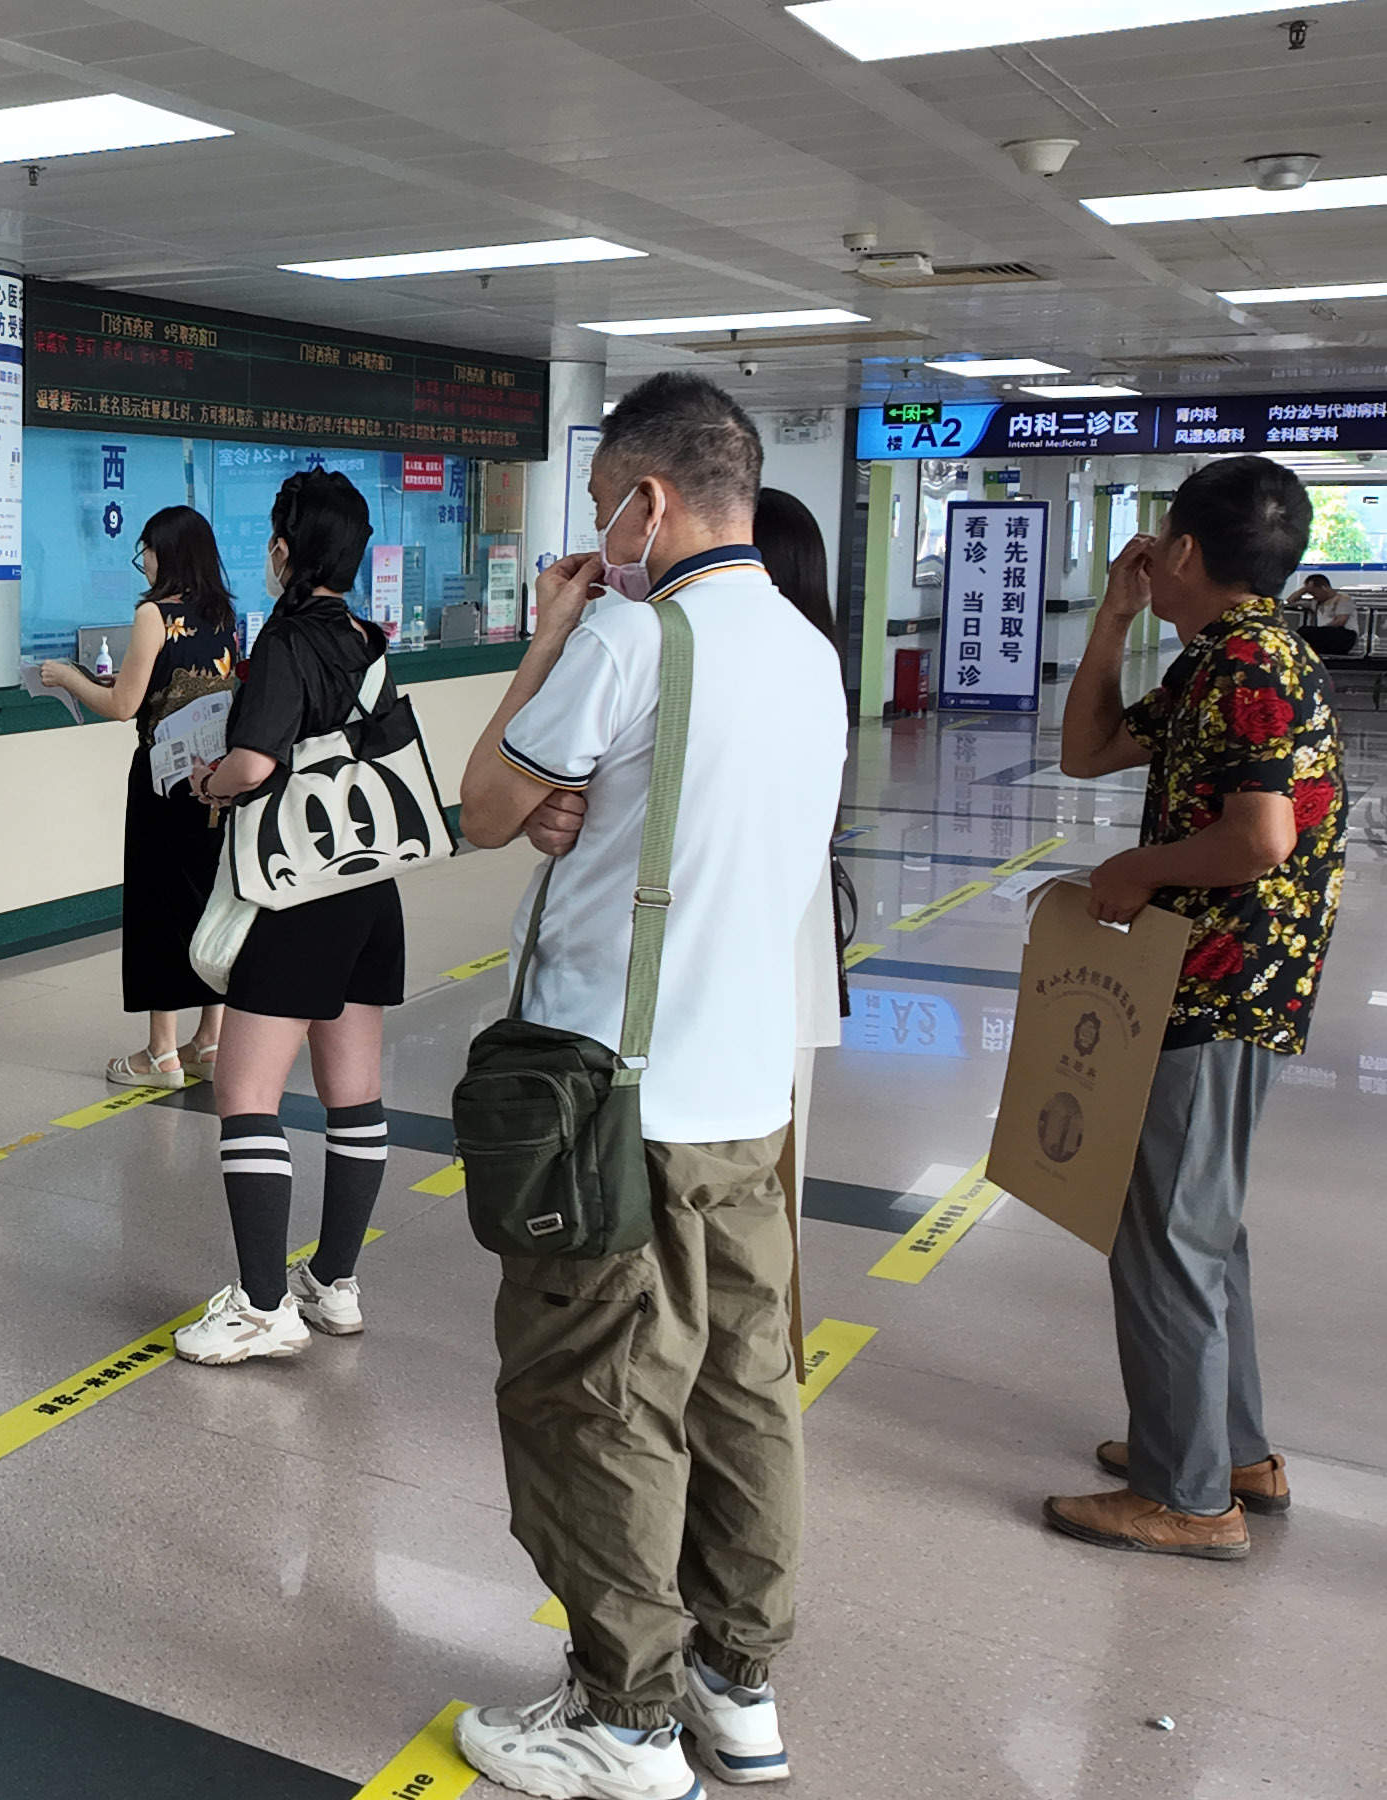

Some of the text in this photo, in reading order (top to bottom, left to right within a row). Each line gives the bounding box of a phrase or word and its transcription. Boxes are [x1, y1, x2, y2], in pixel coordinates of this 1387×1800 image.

[911, 418, 962, 448] A2
[1008, 411, 1140, 438] 内科二诊区
[1174, 425, 1339, 444] 风湿免疫科 全科医学科
[1008, 439, 1043, 449] Internal
[1045, 439, 1087, 449] Medicine
[101, 445, 127, 490] 西
[108, 510, 119, 528] 9
[957, 516, 988, 687] 看诊、当日回诊
[999, 516, 1030, 664] 请先报到取号
